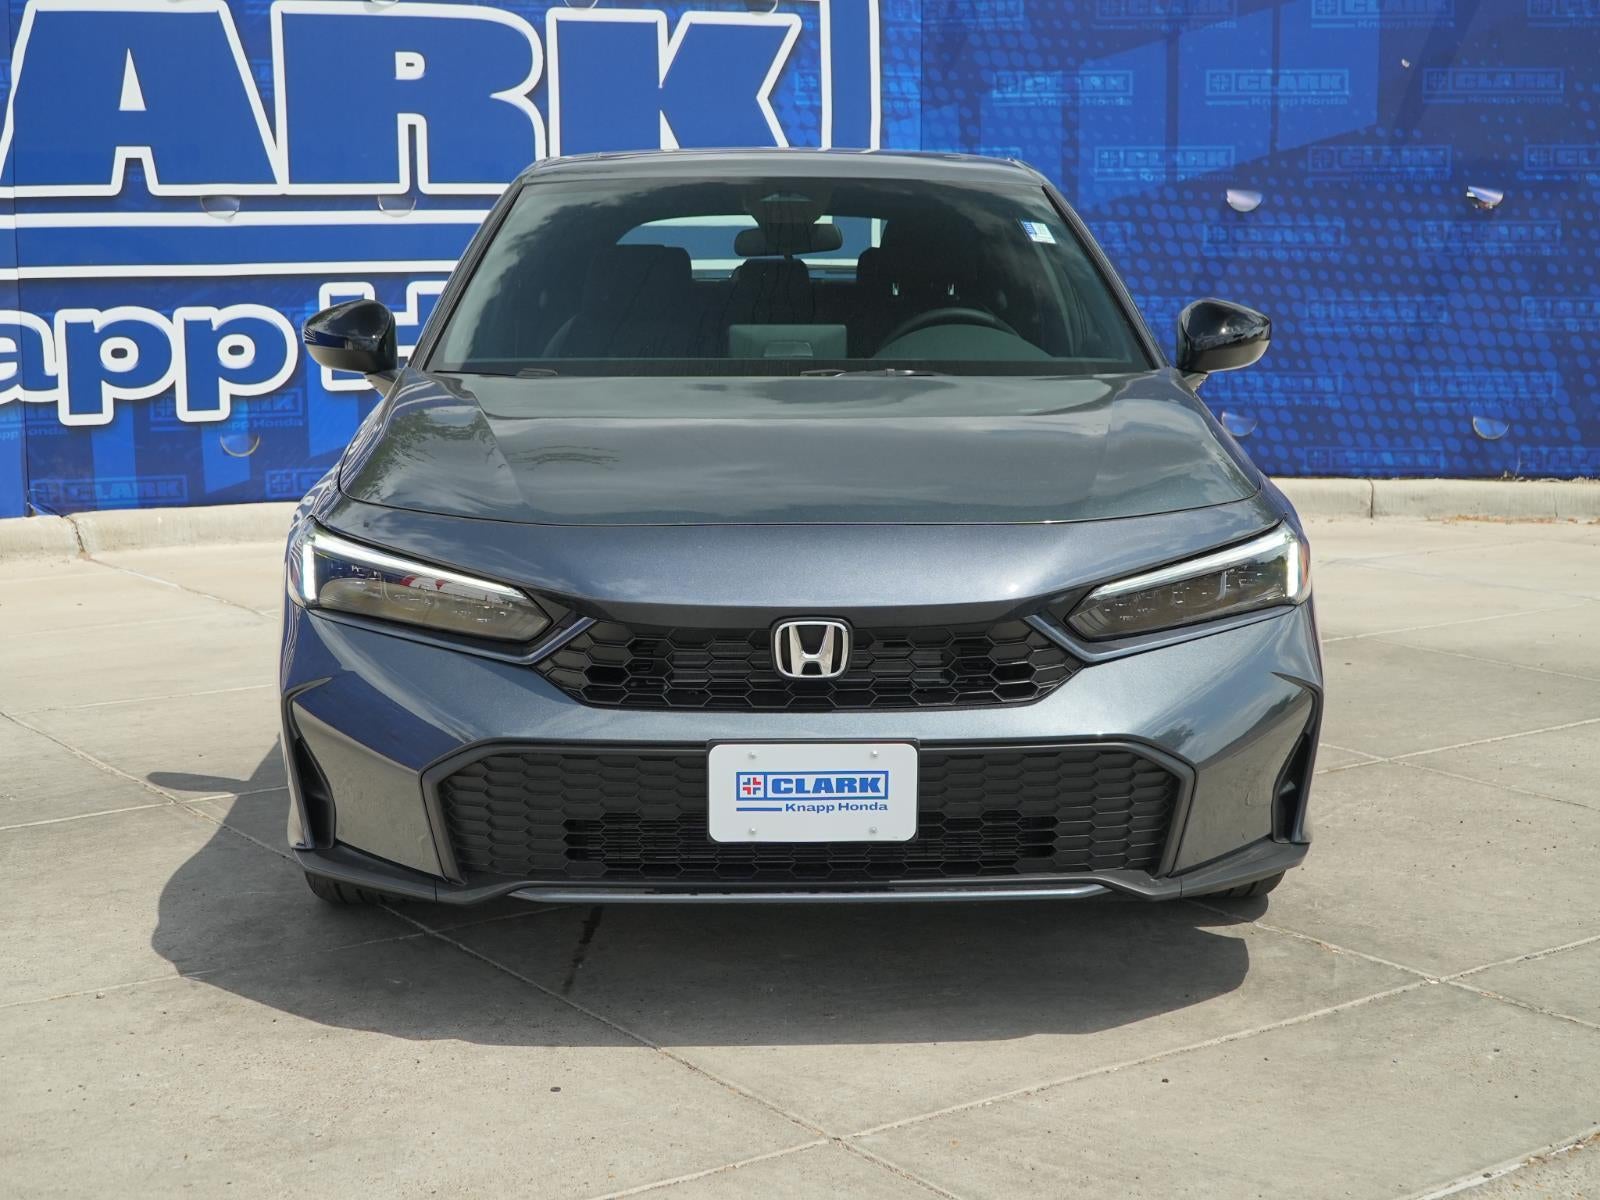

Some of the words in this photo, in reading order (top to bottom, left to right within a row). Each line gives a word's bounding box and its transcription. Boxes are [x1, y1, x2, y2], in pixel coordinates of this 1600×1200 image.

[771, 777, 881, 795] CLARK
[785, 803, 835, 814] Knapp
[838, 801, 888, 812] Honda
